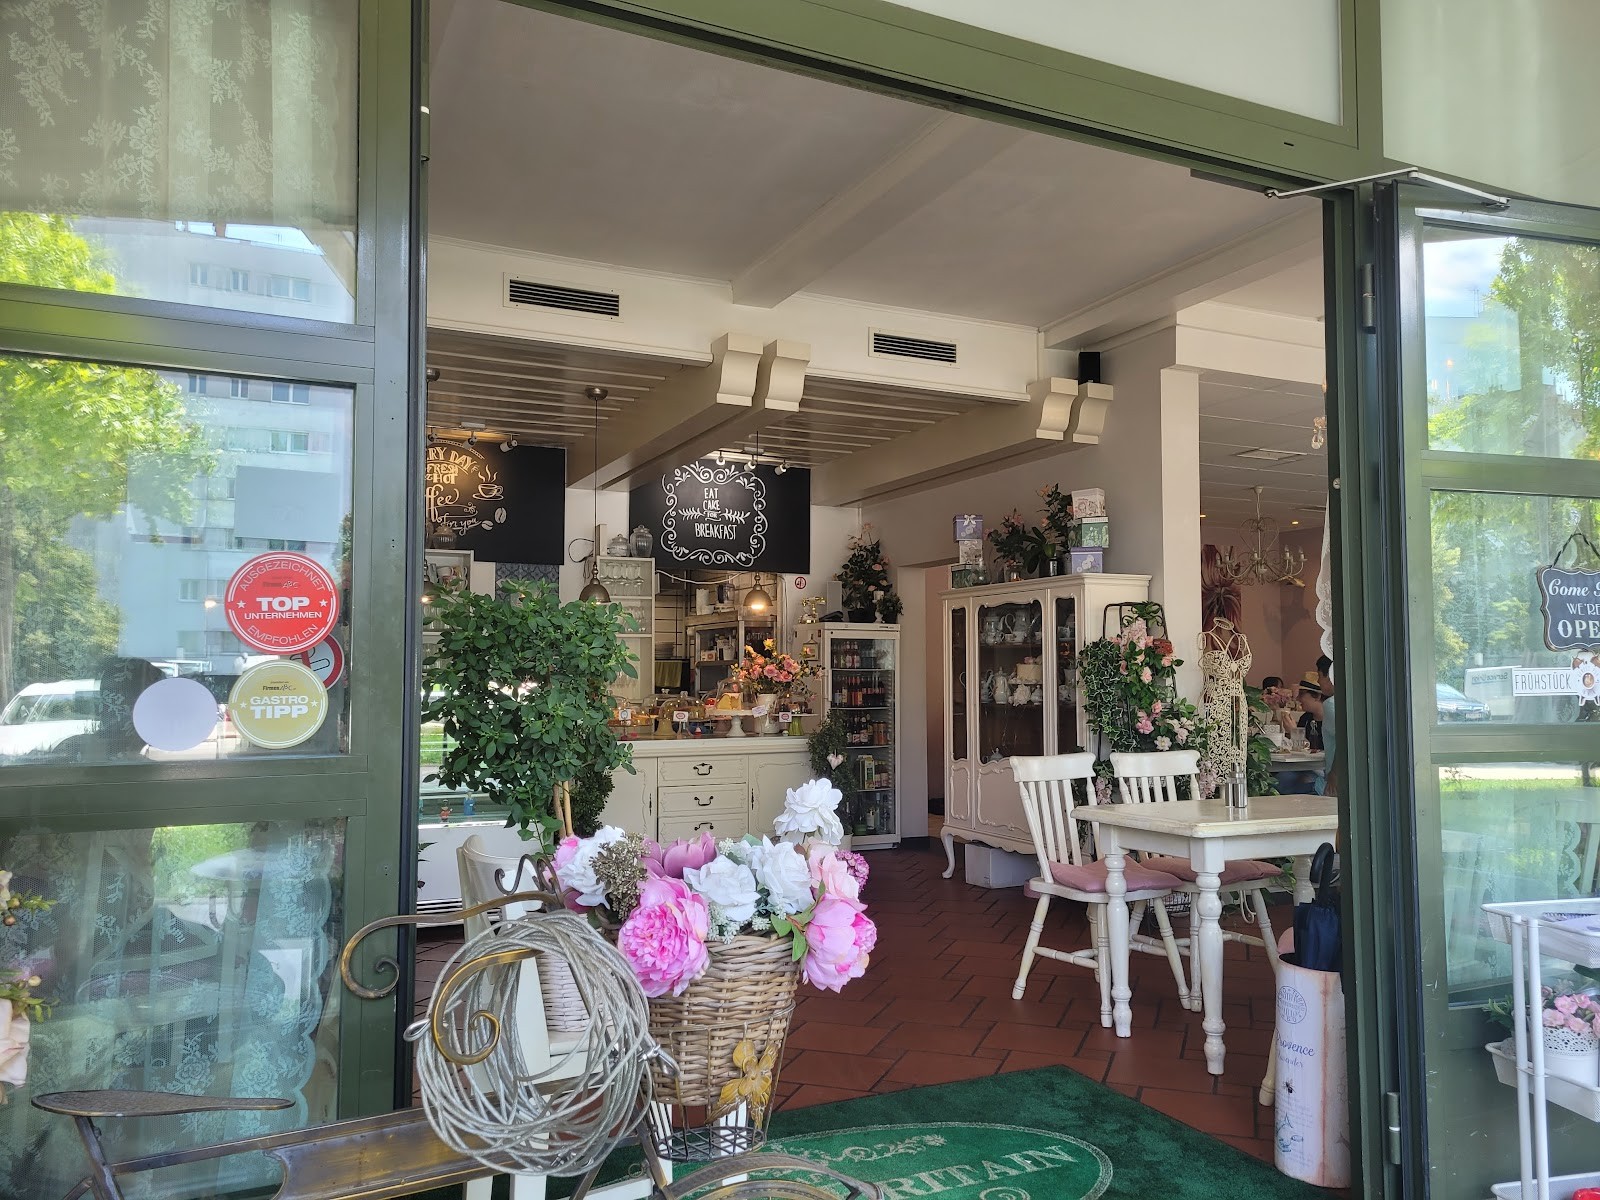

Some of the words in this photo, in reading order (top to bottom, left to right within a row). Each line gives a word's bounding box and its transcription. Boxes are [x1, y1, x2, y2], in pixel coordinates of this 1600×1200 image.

[427, 446, 447, 460] RY
[449, 450, 477, 471] DAY
[704, 488, 719, 499] EAT
[426, 483, 460, 523] ffee
[703, 500, 720, 511] CAKE
[459, 518, 482, 536] you
[695, 523, 737, 540] BREAKFAST
[240, 561, 326, 592] AUSGEZEICHNET
[1548, 578, 1591, 597] Come
[256, 597, 310, 612] TOP
[244, 611, 322, 620] UNTERNEHMEN
[247, 623, 319, 645] EMPFOHLEN
[1557, 619, 1600, 639] OPE
[1514, 673, 1572, 690] FRÜHSTÜCK
[250, 695, 309, 705] GASTRO
[250, 705, 309, 720] TIPP
[876, 1145, 1079, 1200] RITAIN
